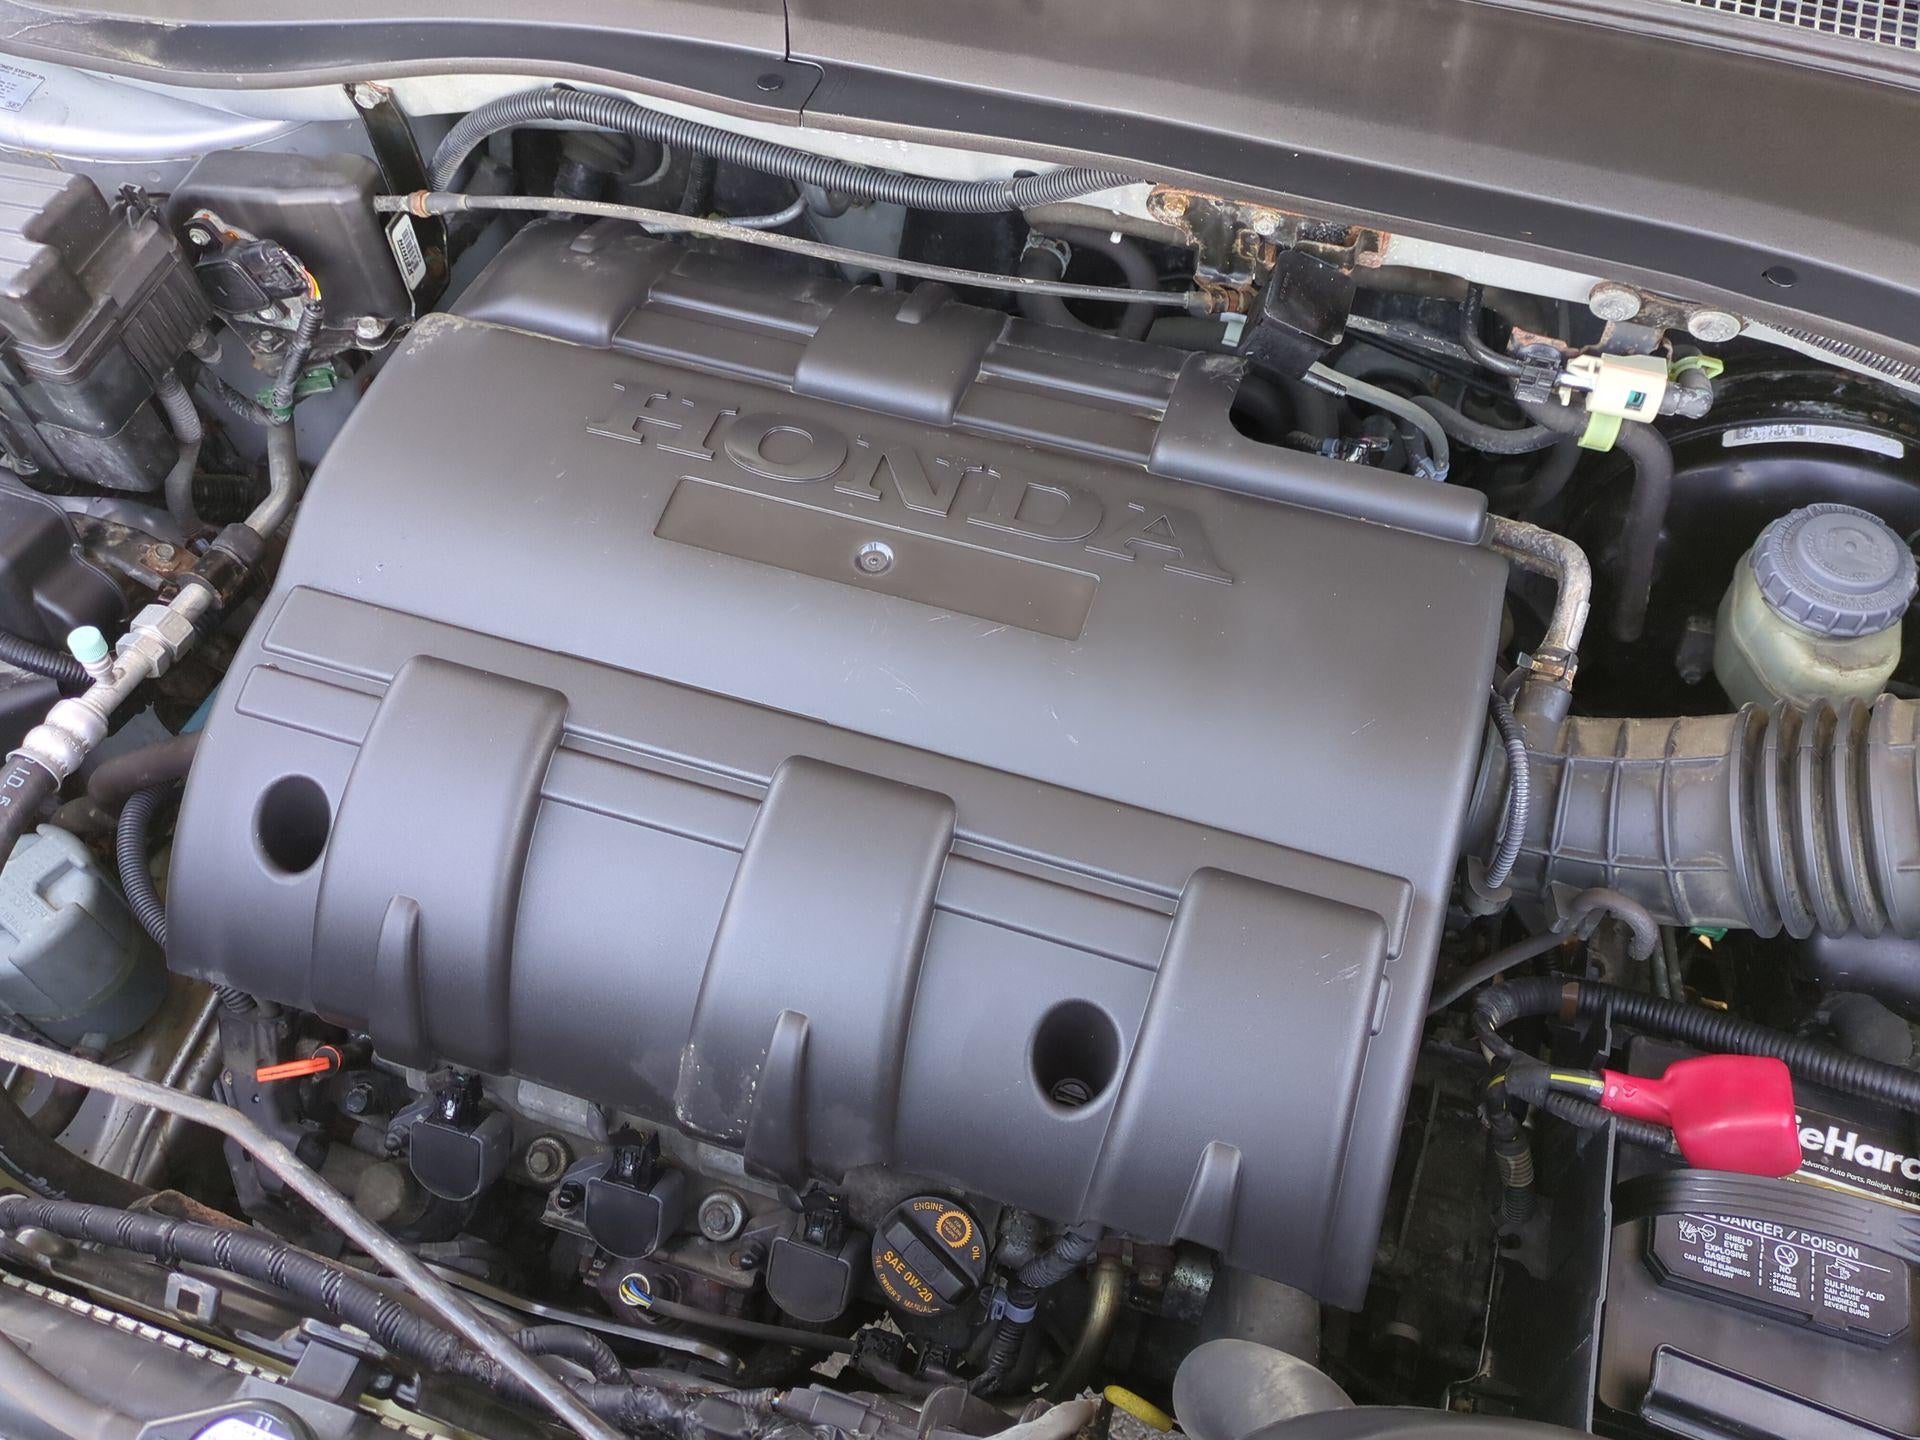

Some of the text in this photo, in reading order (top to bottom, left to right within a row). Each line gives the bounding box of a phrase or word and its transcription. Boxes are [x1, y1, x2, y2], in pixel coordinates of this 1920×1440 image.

[587, 381, 1234, 585] HONDA
[1801, 1158, 1829, 1172] Advance
[1829, 1167, 1846, 1178] Auto
[1893, 1186, 1904, 1196] NC
[913, 1202, 980, 1260] ENGINE OIL
[1719, 1216, 1784, 1238] DANGER
[1800, 1232, 1860, 1260] POISON
[1723, 1232, 1754, 1248] SHIELD
[1723, 1240, 1746, 1253] EYES
[1683, 1252, 1697, 1263] CAN
[1704, 1242, 1750, 1262] EXPLOSIVE
[1704, 1250, 1733, 1265] GASES
[883, 1250, 933, 1303] SAE 0W-20
[1772, 1271, 1798, 1284] SPARKS
[1778, 1265, 1793, 1275] NO
[1772, 1278, 1798, 1291] FLAMES
[1772, 1285, 1802, 1299] SMOKING
[1823, 1278, 1886, 1302] SULFURIC ACID
[1823, 1286, 1861, 1302] CAN CAUSE
[1859, 1304, 1870, 1312] OR
